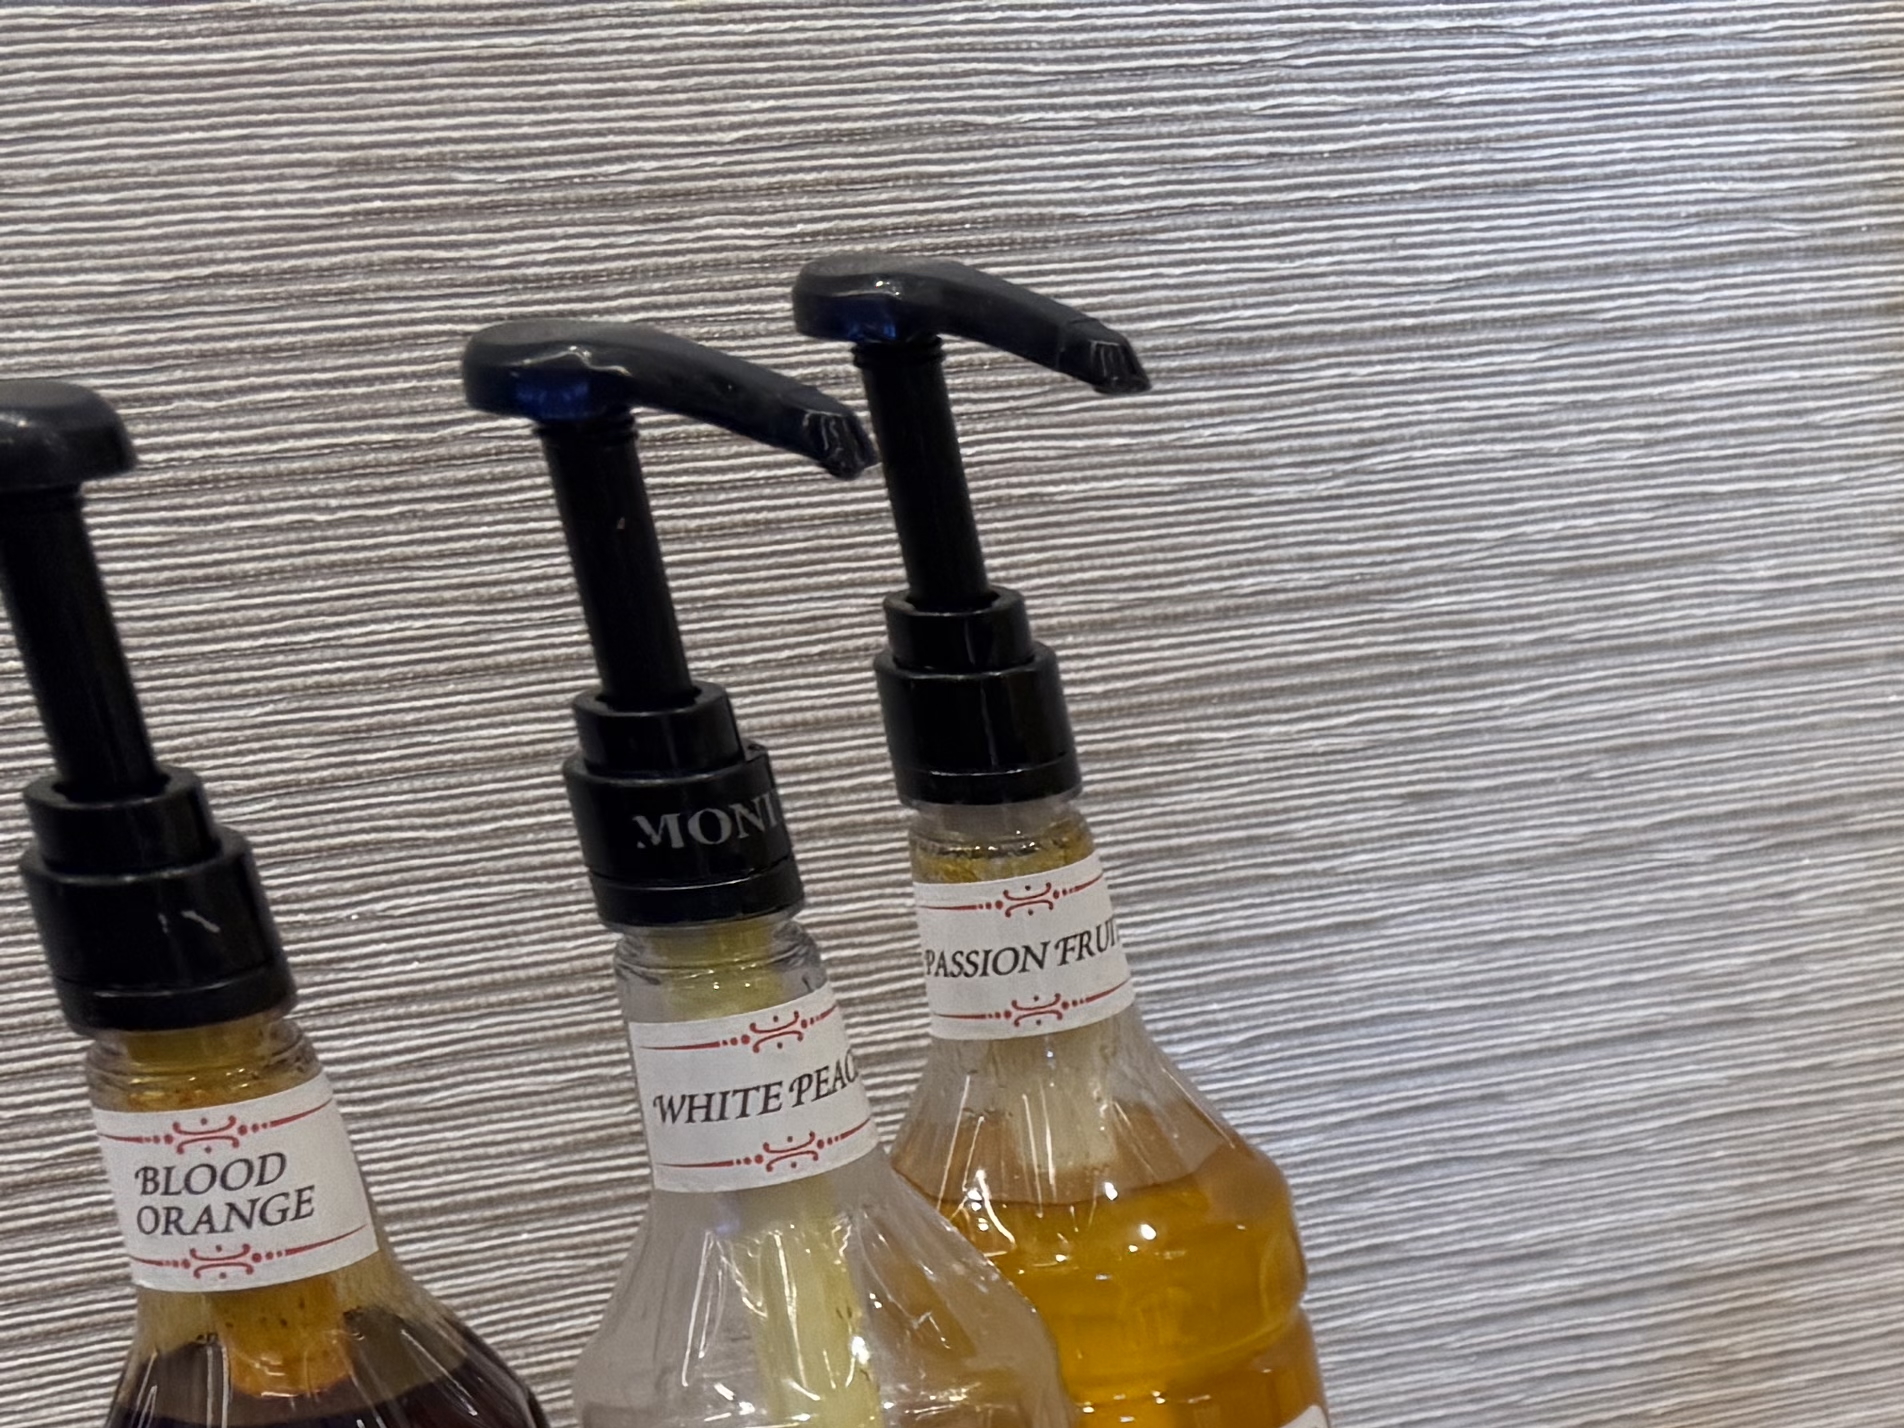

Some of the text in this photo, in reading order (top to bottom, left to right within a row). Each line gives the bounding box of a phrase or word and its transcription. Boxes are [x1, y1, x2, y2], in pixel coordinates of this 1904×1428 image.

[632, 792, 778, 850] MONI
[924, 916, 1118, 979] PASSION FRUI
[652, 1048, 860, 1124] WHITE PEAC
[134, 1151, 288, 1197] BLOOD
[136, 1185, 316, 1238] ORANGE
